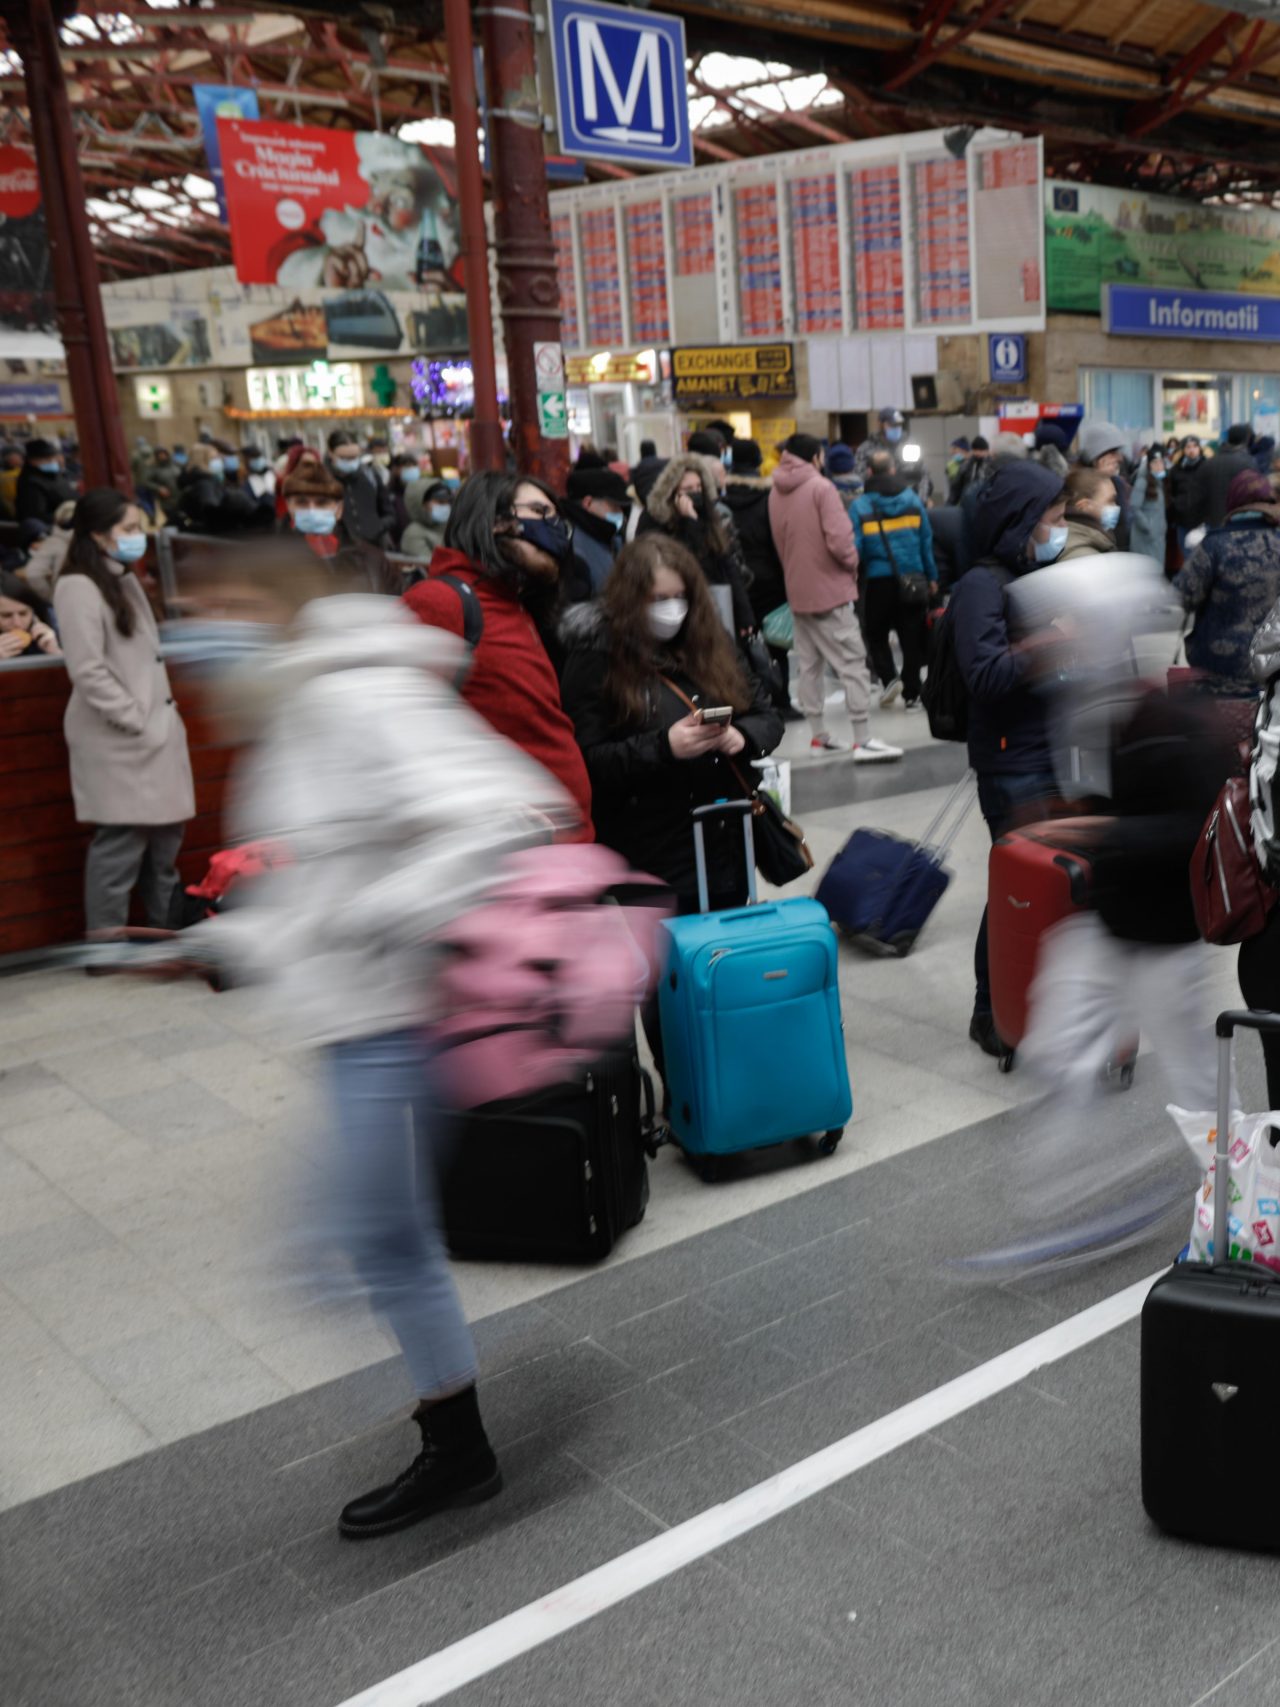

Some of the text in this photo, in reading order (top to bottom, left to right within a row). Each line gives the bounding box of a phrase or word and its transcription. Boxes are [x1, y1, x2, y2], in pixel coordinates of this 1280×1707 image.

[577, 17, 664, 130] M
[678, 351, 753, 371] EXCHANGE
[676, 374, 736, 392] AMANET
